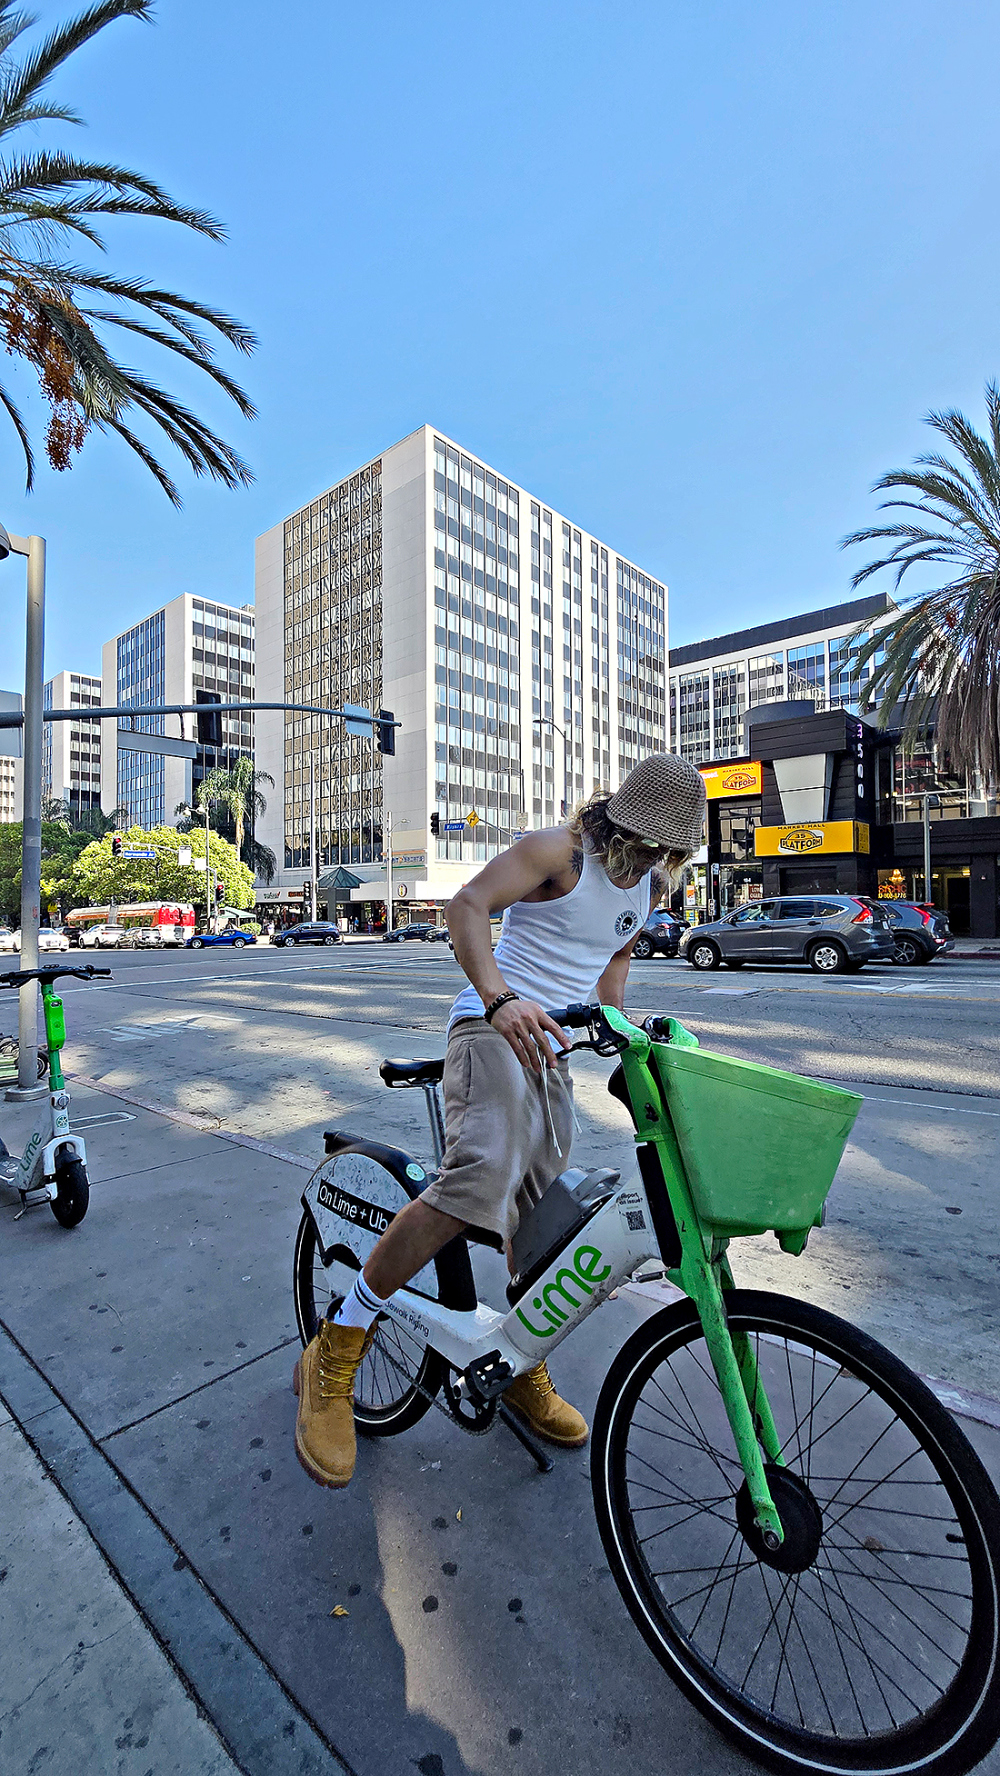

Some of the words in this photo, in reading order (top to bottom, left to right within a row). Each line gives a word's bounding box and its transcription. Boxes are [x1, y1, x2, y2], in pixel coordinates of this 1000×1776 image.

[782, 839, 821, 850] PLATFORM
[20, 1132, 42, 1171] Lime
[319, 1185, 333, 1206] On
[332, 1191, 358, 1218] Lime
[515, 1244, 612, 1338] Lime
